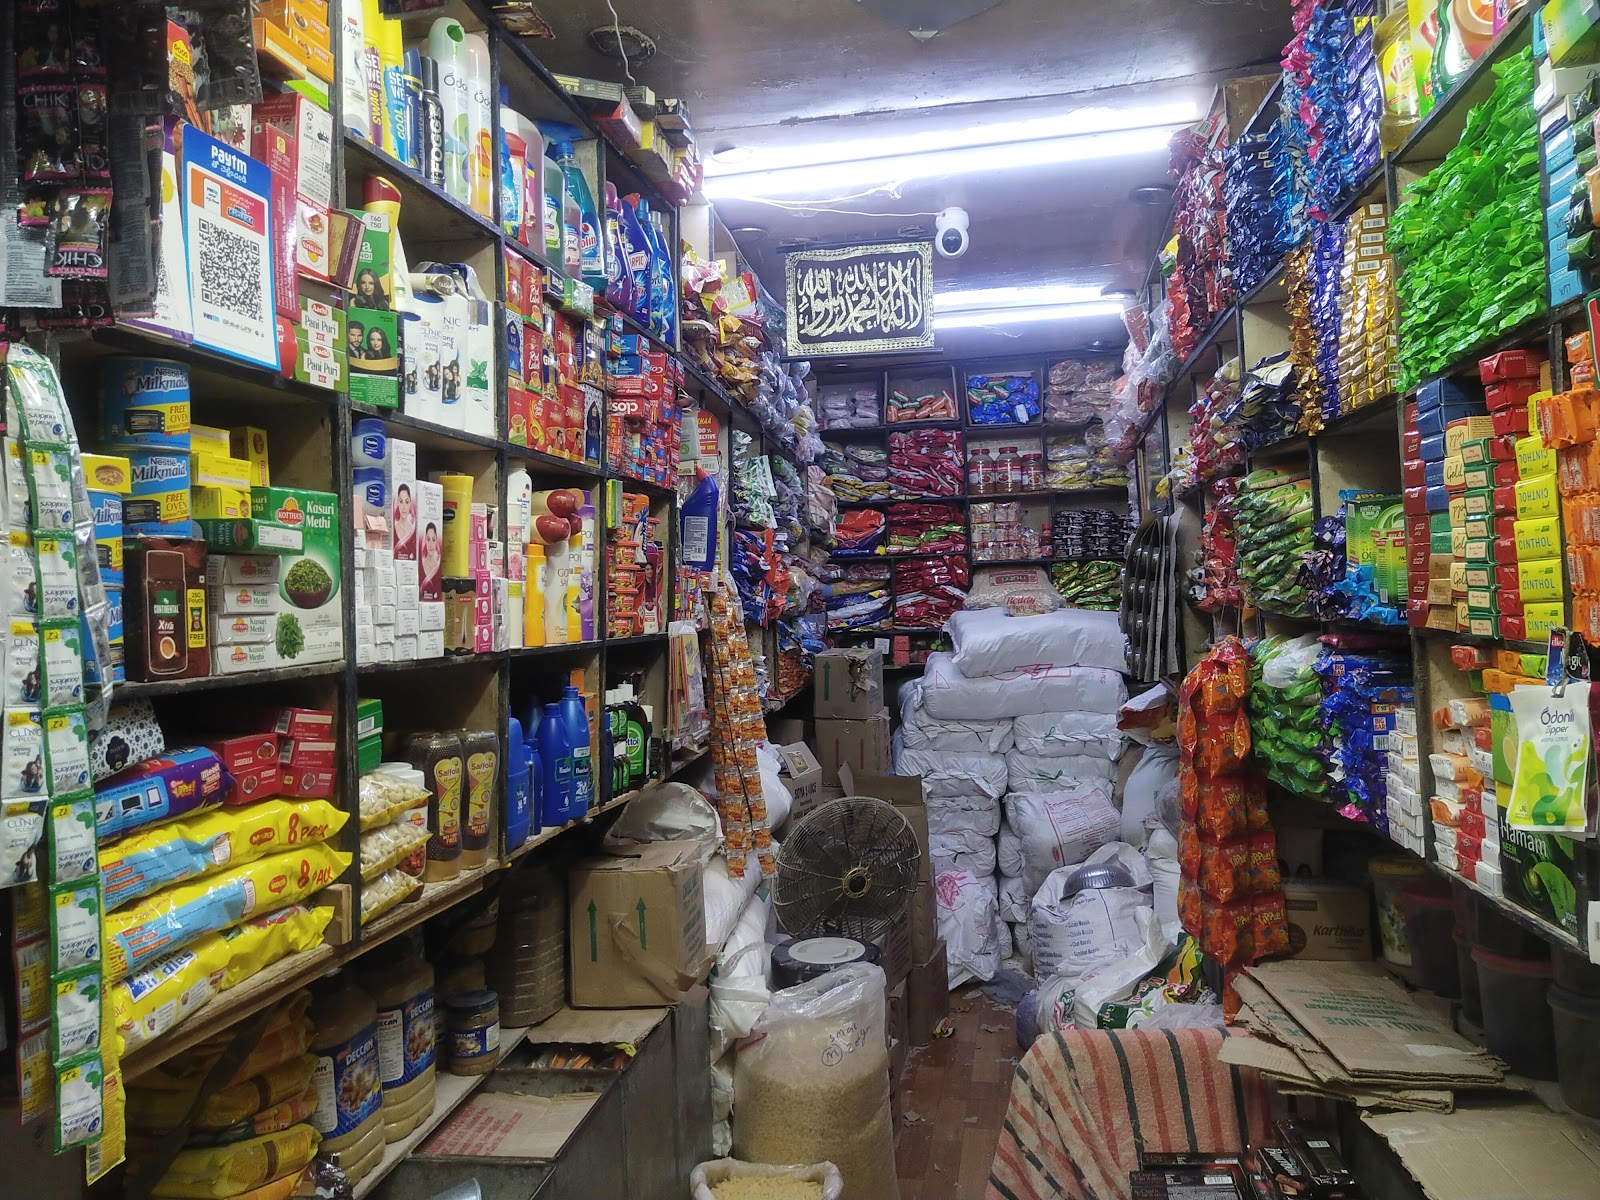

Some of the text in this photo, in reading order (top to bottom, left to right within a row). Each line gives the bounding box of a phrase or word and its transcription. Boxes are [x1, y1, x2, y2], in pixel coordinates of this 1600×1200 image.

[343, 23, 362, 39] Dove
[1389, 55, 1413, 83] Vim
[1586, 69, 1600, 80] Do
[366, 70, 381, 85] WE
[391, 86, 405, 101] WE
[23, 94, 69, 108] CHIK
[368, 89, 382, 126] SWAG
[394, 108, 406, 140] COOL
[54, 252, 104, 267] CHIK
[630, 254, 645, 268] RPIC
[311, 304, 329, 315] Aachi
[305, 315, 337, 336] Pani Puri
[443, 316, 461, 327] NIC
[314, 346, 330, 357] Aachi
[307, 358, 338, 377] Pani Puri
[136, 376, 188, 391] Milkmaid
[170, 405, 187, 414] FREE
[612, 402, 639, 413] clos
[170, 414, 188, 423] OVEN
[1518, 449, 1548, 463] CINTHOL
[132, 464, 186, 482] Milkmaid
[1446, 465, 1463, 479] Gold
[166, 492, 185, 503] FREE
[252, 496, 267, 505] suri
[1518, 488, 1549, 502] CINTHOL
[104, 500, 122, 509] Nest
[166, 502, 188, 512] OVEN
[306, 500, 334, 515] Kasuri
[93, 509, 122, 525] Milkm
[305, 515, 331, 529] Methi
[1453, 537, 1466, 550] Gol
[1518, 537, 1552, 550] CINTHOL
[1522, 578, 1555, 590] CINTHOL
[188, 597, 204, 605] Pouch
[253, 597, 268, 605] Methi
[153, 604, 179, 614] CONTINENTAL
[250, 618, 267, 626] Kasuri
[250, 625, 265, 633] Methi
[14, 638, 38, 648] CLIN
[249, 653, 265, 661] Methi
[59, 684, 74, 693] head
[10, 728, 42, 738] CLINIC
[1546, 724, 1569, 735] Zipper
[438, 766, 460, 779] Saffola
[471, 761, 494, 772] Saffola
[62, 772, 79, 783] head
[289, 813, 328, 844] 8 PACK
[1502, 843, 1517, 853] NEEM
[68, 859, 84, 870] head
[298, 860, 333, 889] 8 PACK
[410, 998, 434, 1018] DECCAN
[378, 1019, 398, 1027] CCAN
[345, 1040, 373, 1066] DECCAN
[73, 1119, 91, 1132] head
